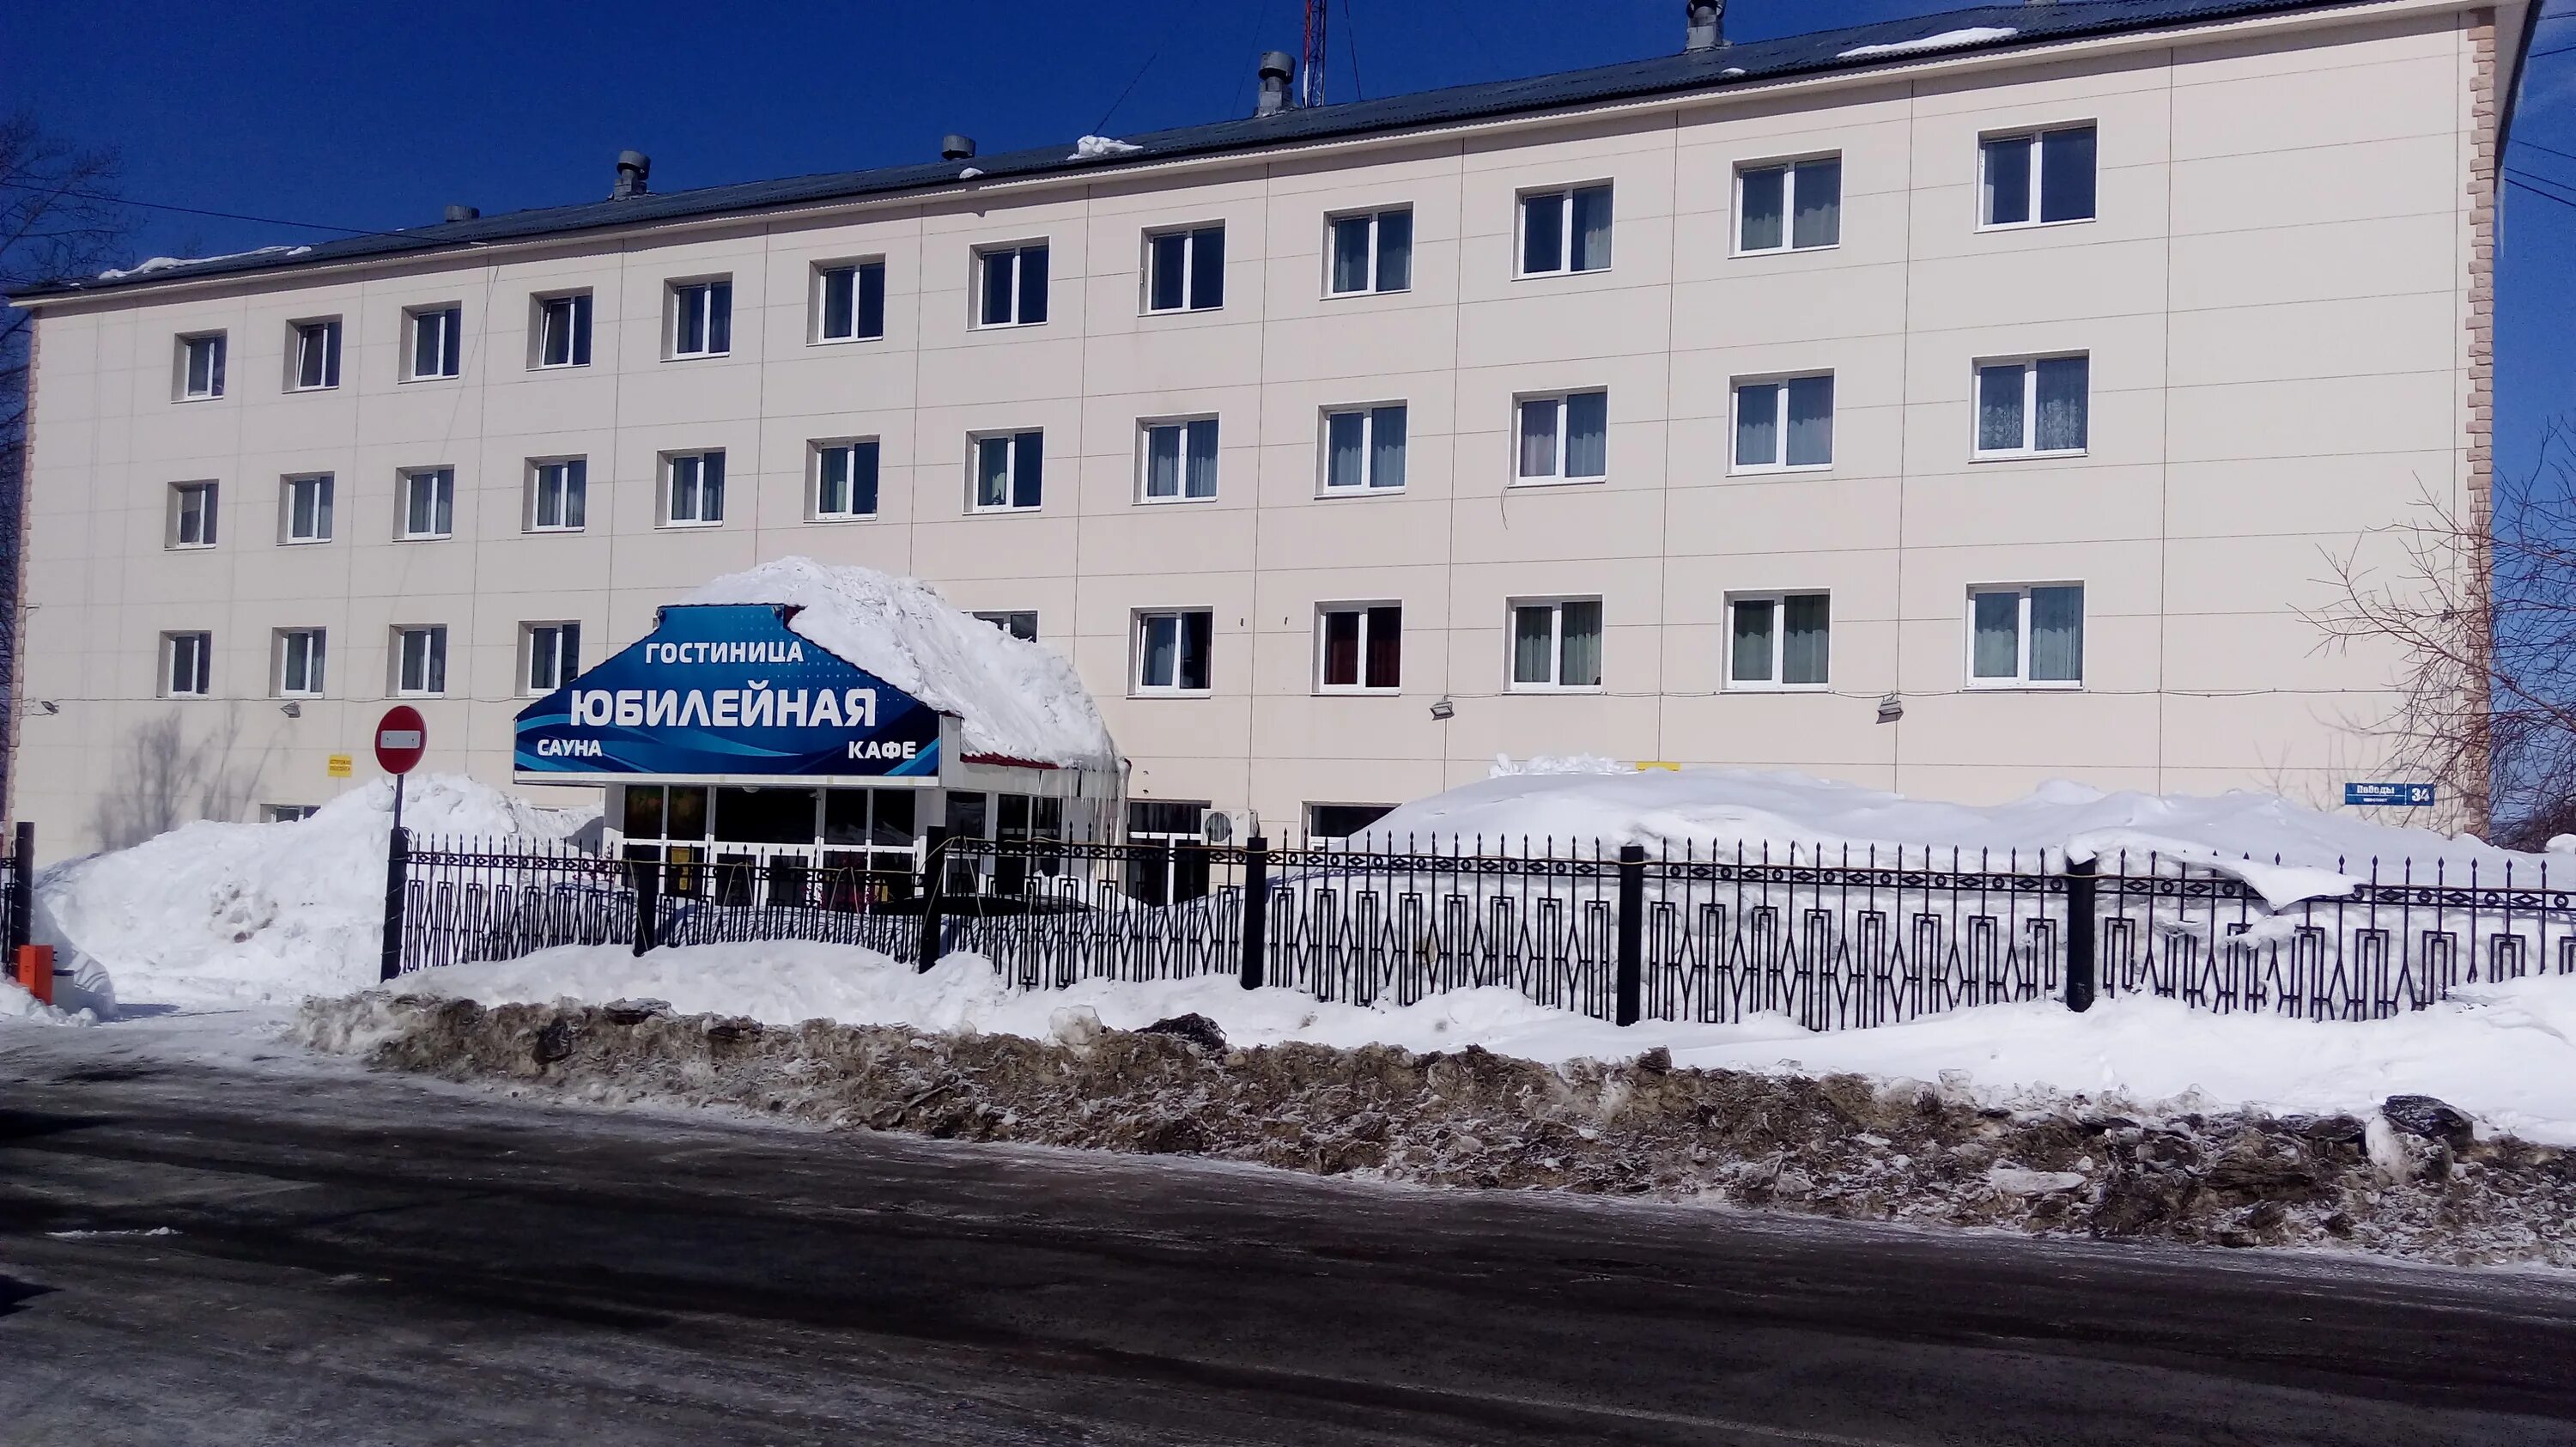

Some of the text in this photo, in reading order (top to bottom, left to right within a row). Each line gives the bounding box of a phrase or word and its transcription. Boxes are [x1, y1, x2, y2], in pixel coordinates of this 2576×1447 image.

[646, 642, 805, 664] ГОСТИНИЦА
[570, 679, 876, 727] ЮБИЛЕЙНАЯ
[537, 739, 603, 757] САУНА
[848, 741, 917, 760] КАФЕ
[2411, 787, 2430, 802] 34
